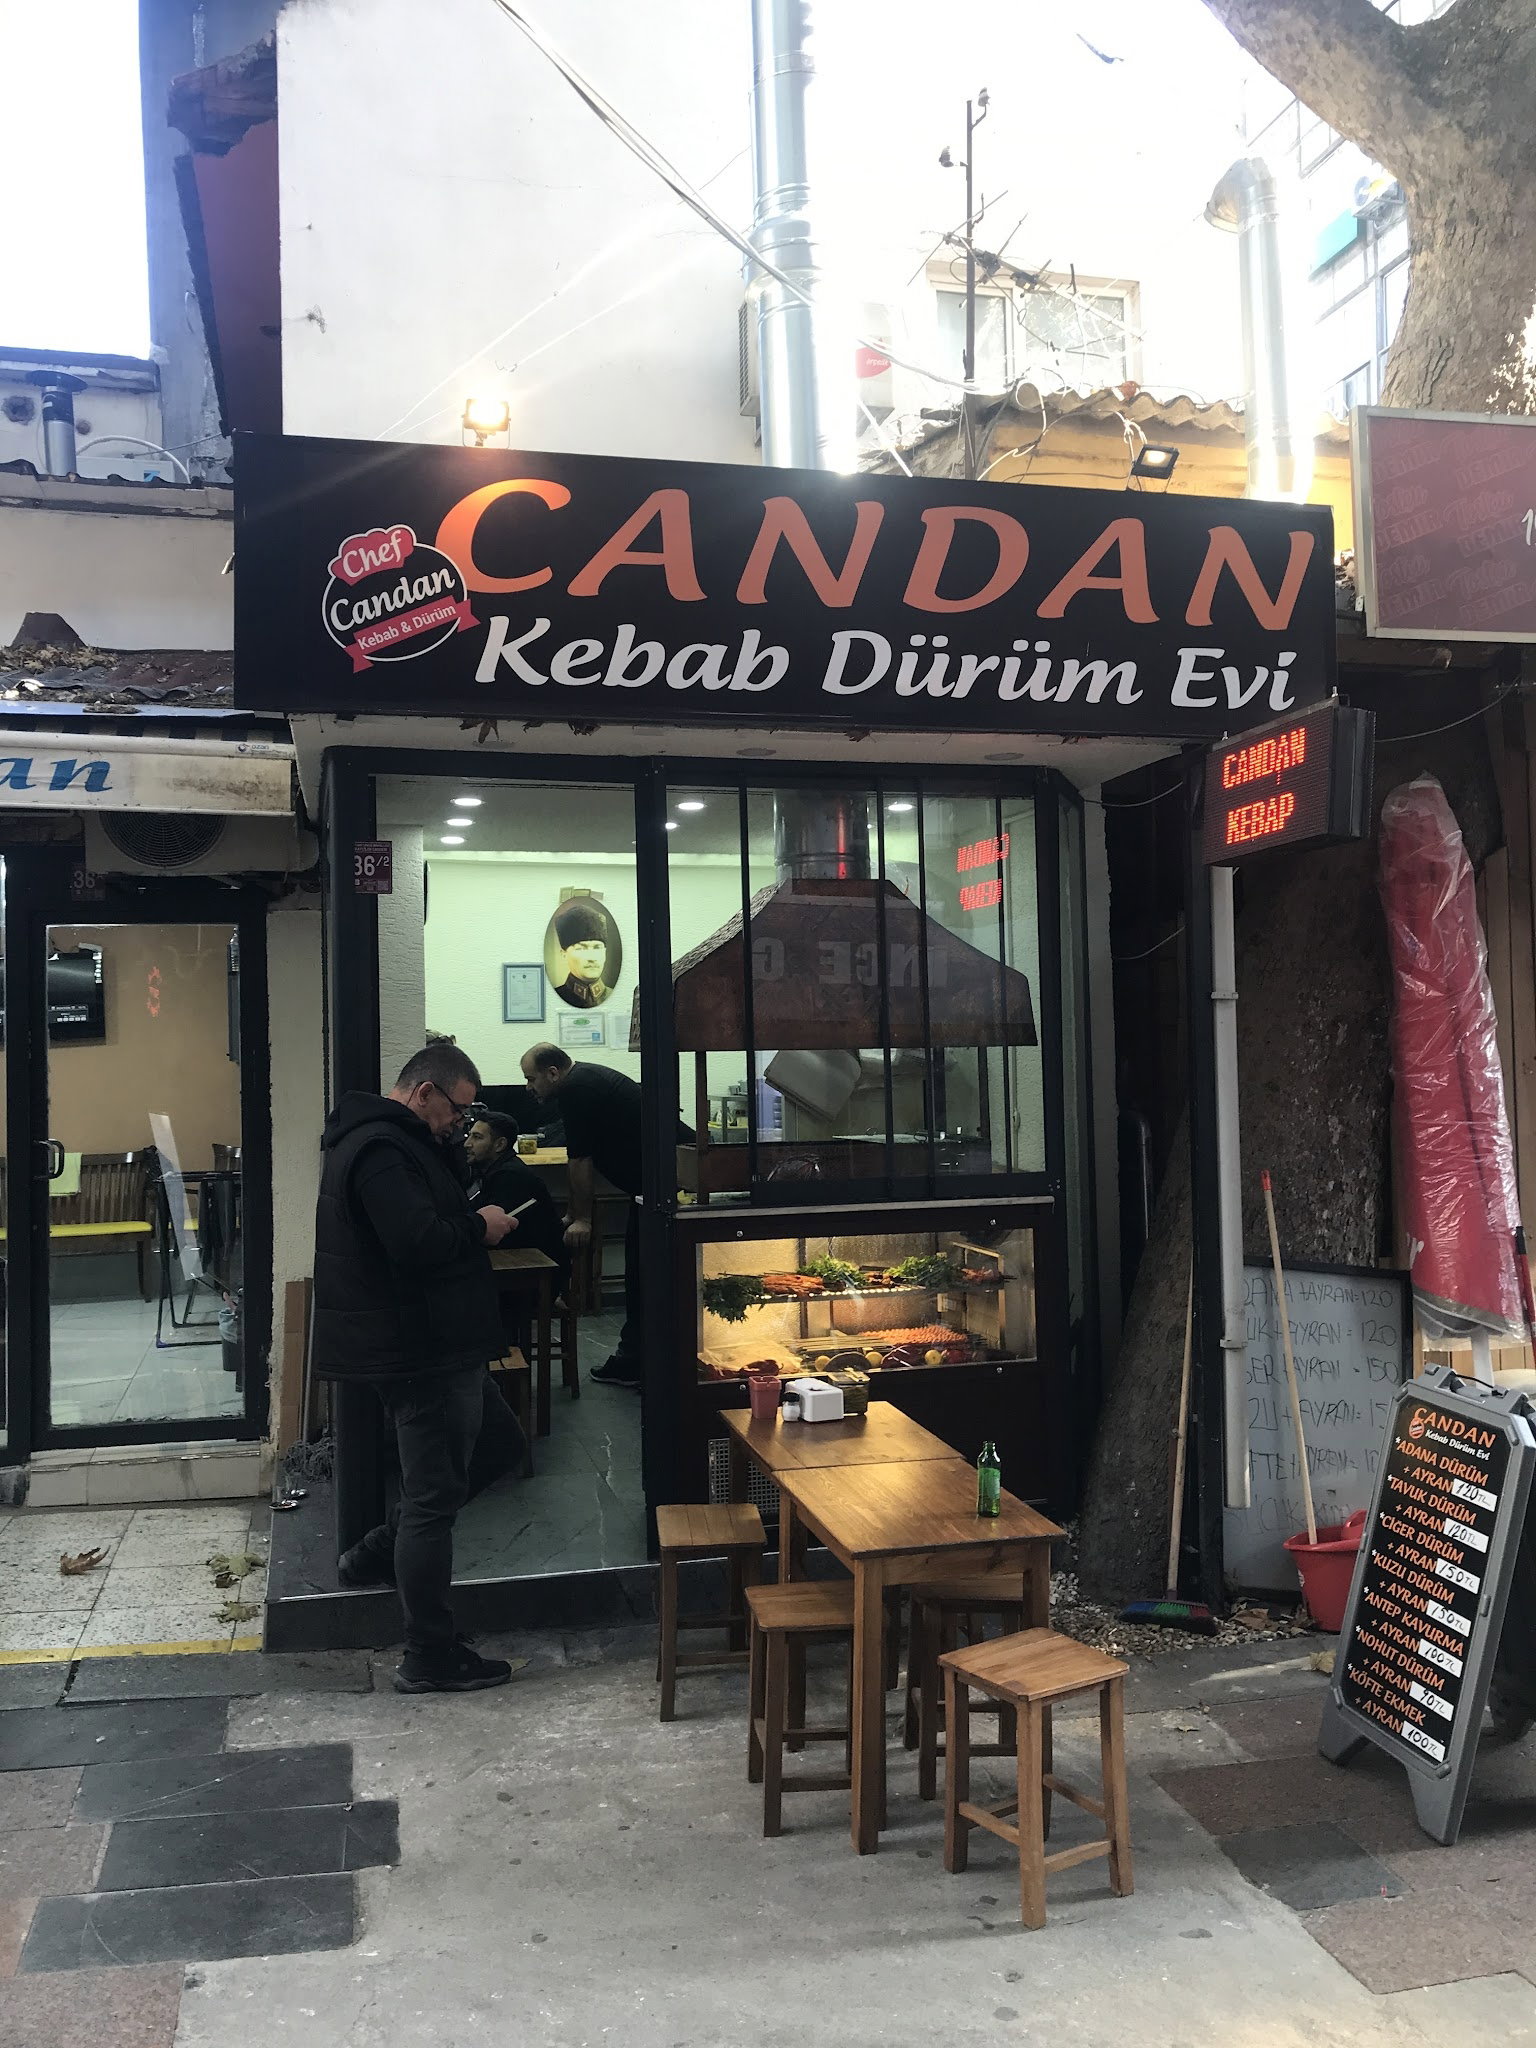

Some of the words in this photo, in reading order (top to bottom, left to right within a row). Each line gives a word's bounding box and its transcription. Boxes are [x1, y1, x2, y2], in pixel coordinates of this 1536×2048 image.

[343, 529, 402, 578] Chef
[435, 478, 1315, 631] CANDAN
[330, 568, 456, 631] Candan
[357, 626, 400, 650] Kebab
[401, 621, 412, 634] &
[412, 605, 457, 629] Dürüm
[475, 615, 790, 692] Kebab
[821, 629, 1143, 705] Dürüm
[1171, 647, 1298, 712] Evi
[1222, 727, 1307, 789] CANDAN
[1226, 792, 1295, 844] KEBAP
[1362, 1320, 1398, 1347] 120
[1367, 1356, 1399, 1384] 150
[1414, 1407, 1496, 1448] CANDAN
[1425, 1430, 1449, 1445] Kebab
[1448, 1438, 1476, 1456] Dürüm
[1476, 1450, 1491, 1461] Evi
[1411, 1467, 1455, 1494] AYRAN
[1440, 1457, 1489, 1487] DÜRÜM
[1403, 1505, 1446, 1533] AYRAN
[1428, 1494, 1477, 1526] DÜRÜM
[1395, 1544, 1437, 1573] AYRAN
[1416, 1531, 1465, 1564] DÜRÜM
[1387, 1582, 1429, 1613] AYRAN
[1407, 1570, 1455, 1605] DÜRÜM
[1379, 1621, 1421, 1653] AYRAN
[1401, 1611, 1465, 1657] KAVURMA
[1370, 1660, 1412, 1694] AYRAN
[1397, 1653, 1446, 1692] DÜRÜM
[1362, 1700, 1404, 1734] AYRAN
[1383, 1689, 1427, 1726] EKMEK
